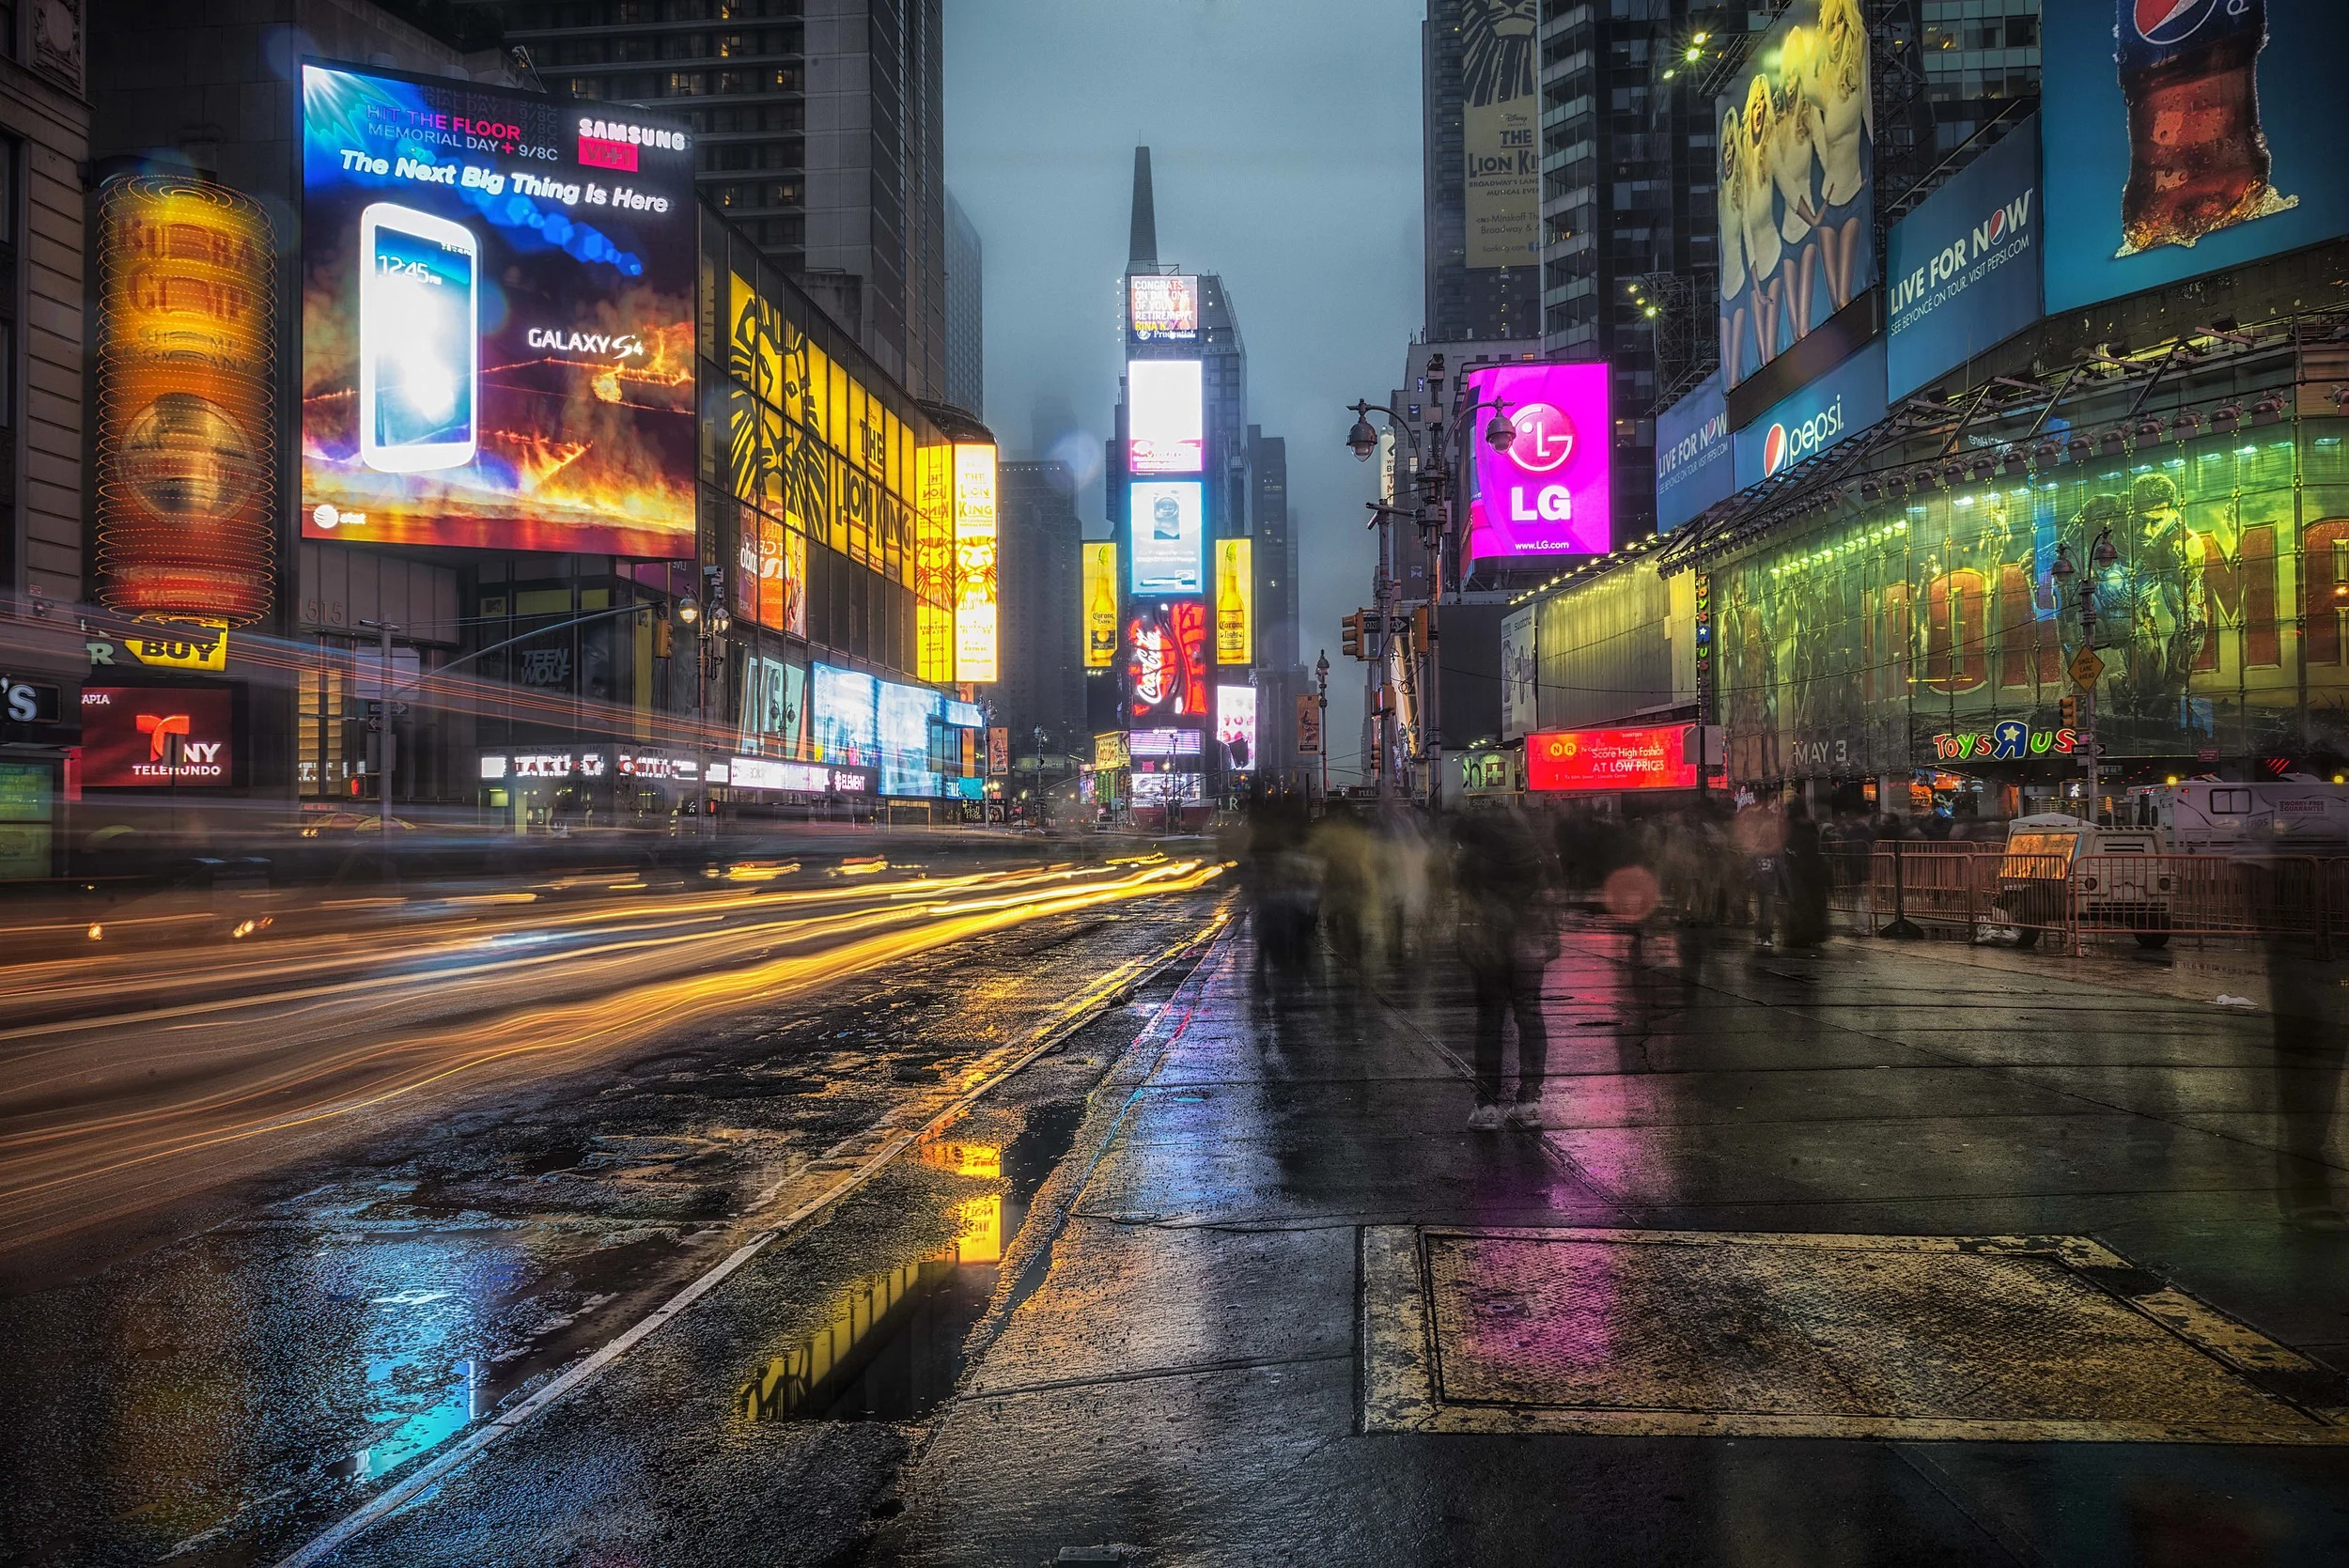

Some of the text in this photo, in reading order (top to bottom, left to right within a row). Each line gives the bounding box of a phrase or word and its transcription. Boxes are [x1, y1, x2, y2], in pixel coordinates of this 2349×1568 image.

[366, 104, 521, 141] HIT THE FLOOR
[367, 122, 461, 147] MEMORIAL
[466, 136, 499, 152] DAY
[518, 144, 558, 161] 9/8C
[578, 118, 686, 151] SAMSUNG
[1500, 130, 1532, 145] THE
[1469, 153, 1512, 178] LION
[339, 149, 668, 213] The Next Big Thing Is Here
[1491, 212, 1526, 223] Minskoff
[1481, 225, 1522, 235] Broadway
[1483, 243, 1526, 254] lionking.com
[1890, 190, 2030, 317] LIVE FOR NOW
[1134, 280, 1184, 290] CONGRATS
[1890, 318, 1902, 336] SEE
[1902, 296, 1933, 328] BEYONCÉ
[1933, 288, 1946, 307] ON
[1968, 262, 1986, 283] VISIT
[1987, 234, 2030, 272] PEPSI.COM
[1135, 290, 1148, 301] ON
[1171, 290, 1190, 301] ONE
[1135, 301, 1146, 310] OF
[528, 327, 611, 354] GALAXY
[1789, 394, 1841, 466] pepsi
[860, 418, 884, 467] THE
[1658, 447, 1676, 479] LIVE
[1678, 433, 1698, 465] FOR
[835, 444, 911, 551] LION KING
[1511, 485, 1572, 521] LG
[958, 501, 993, 518] KING
[1515, 539, 1570, 551] www.LG.com
[1092, 612, 1115, 620] Corona
[1219, 621, 1243, 629] Corona
[141, 641, 221, 662] BUY
[521, 647, 569, 667] TEEN
[2077, 657, 2094, 665] SINGLE
[521, 664, 571, 686] WOLF
[183, 743, 222, 763] NY
[1593, 751, 1616, 759] Score
[1618, 747, 1638, 760] High
[1795, 739, 1846, 766] MAY 3
[1592, 759, 1664, 773] AT LOW PRICES
